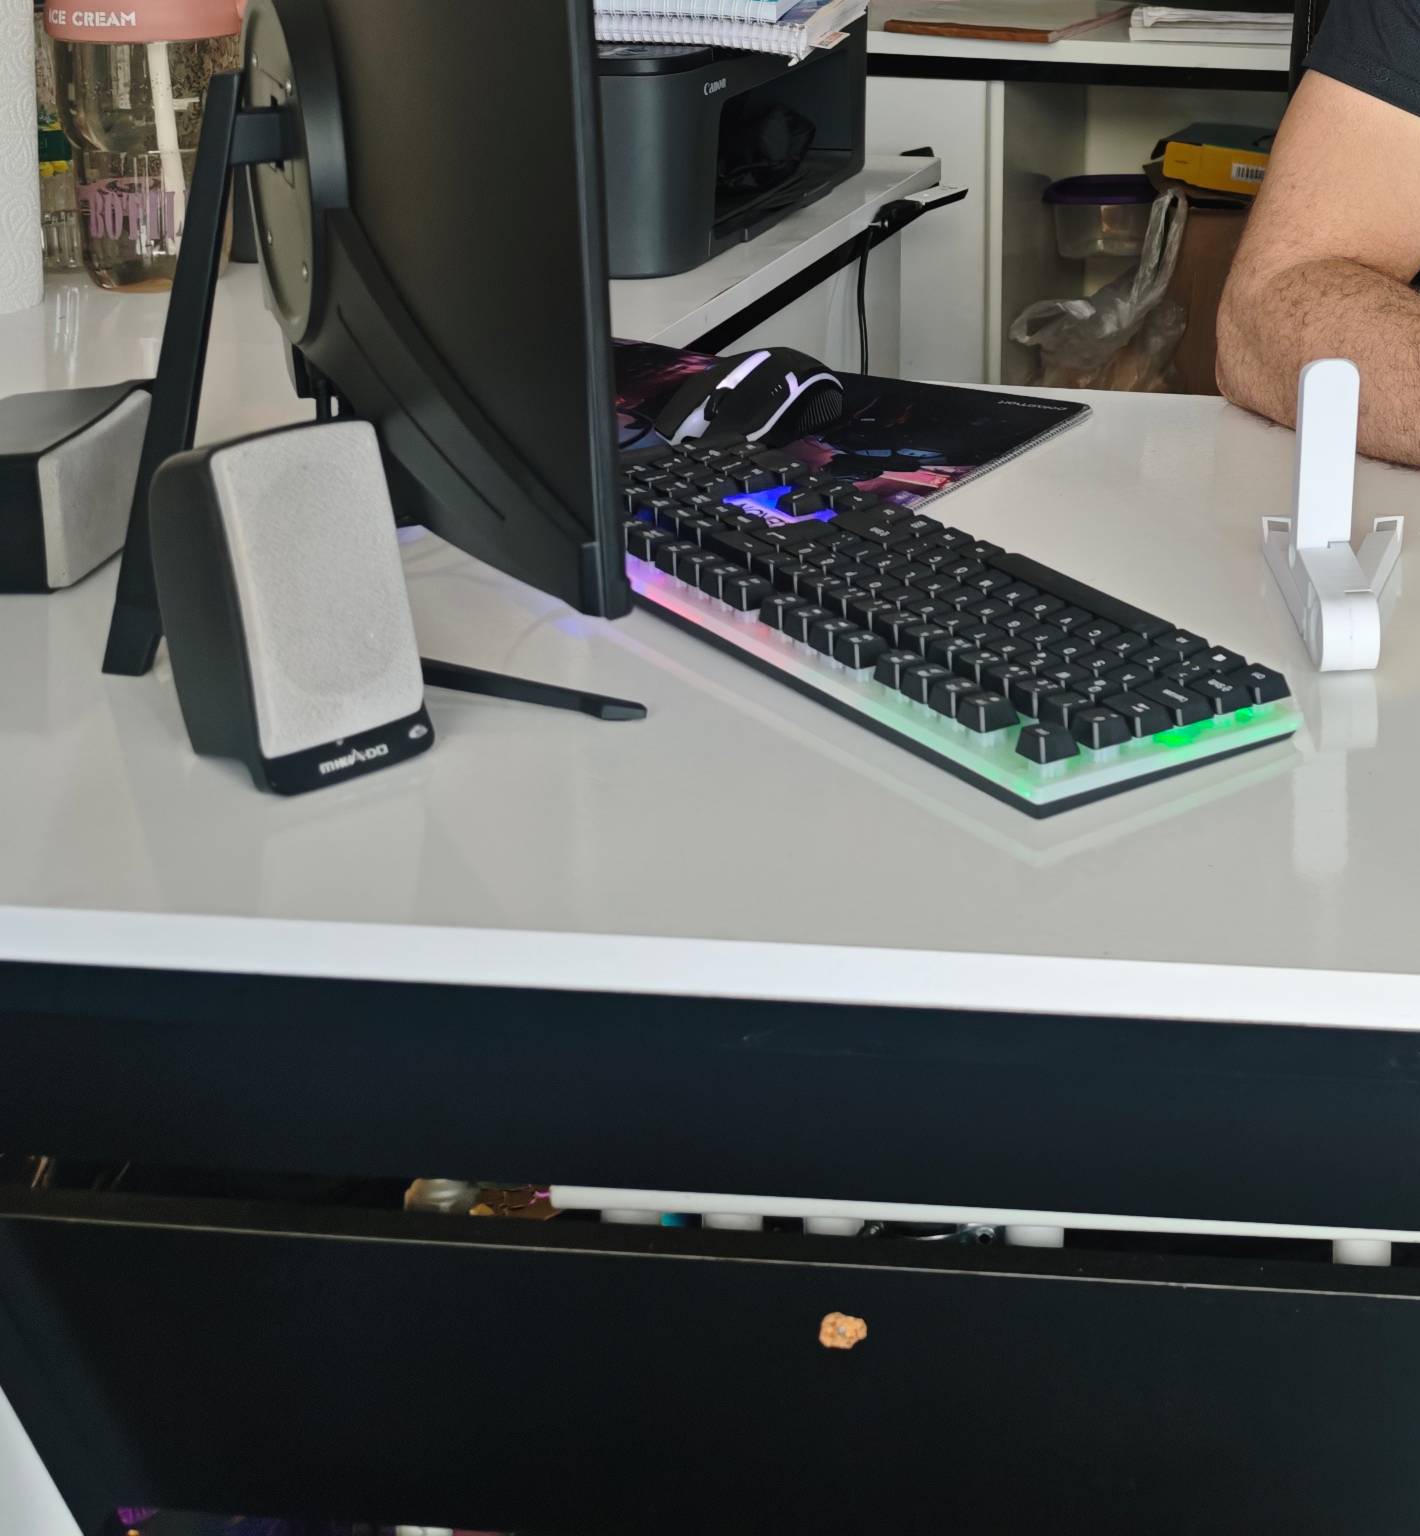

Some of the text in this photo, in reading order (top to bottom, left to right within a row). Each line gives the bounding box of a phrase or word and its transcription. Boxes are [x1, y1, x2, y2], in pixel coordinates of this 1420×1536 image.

[49, 10, 136, 26] ICE CREAM
[703, 77, 726, 96] Canon
